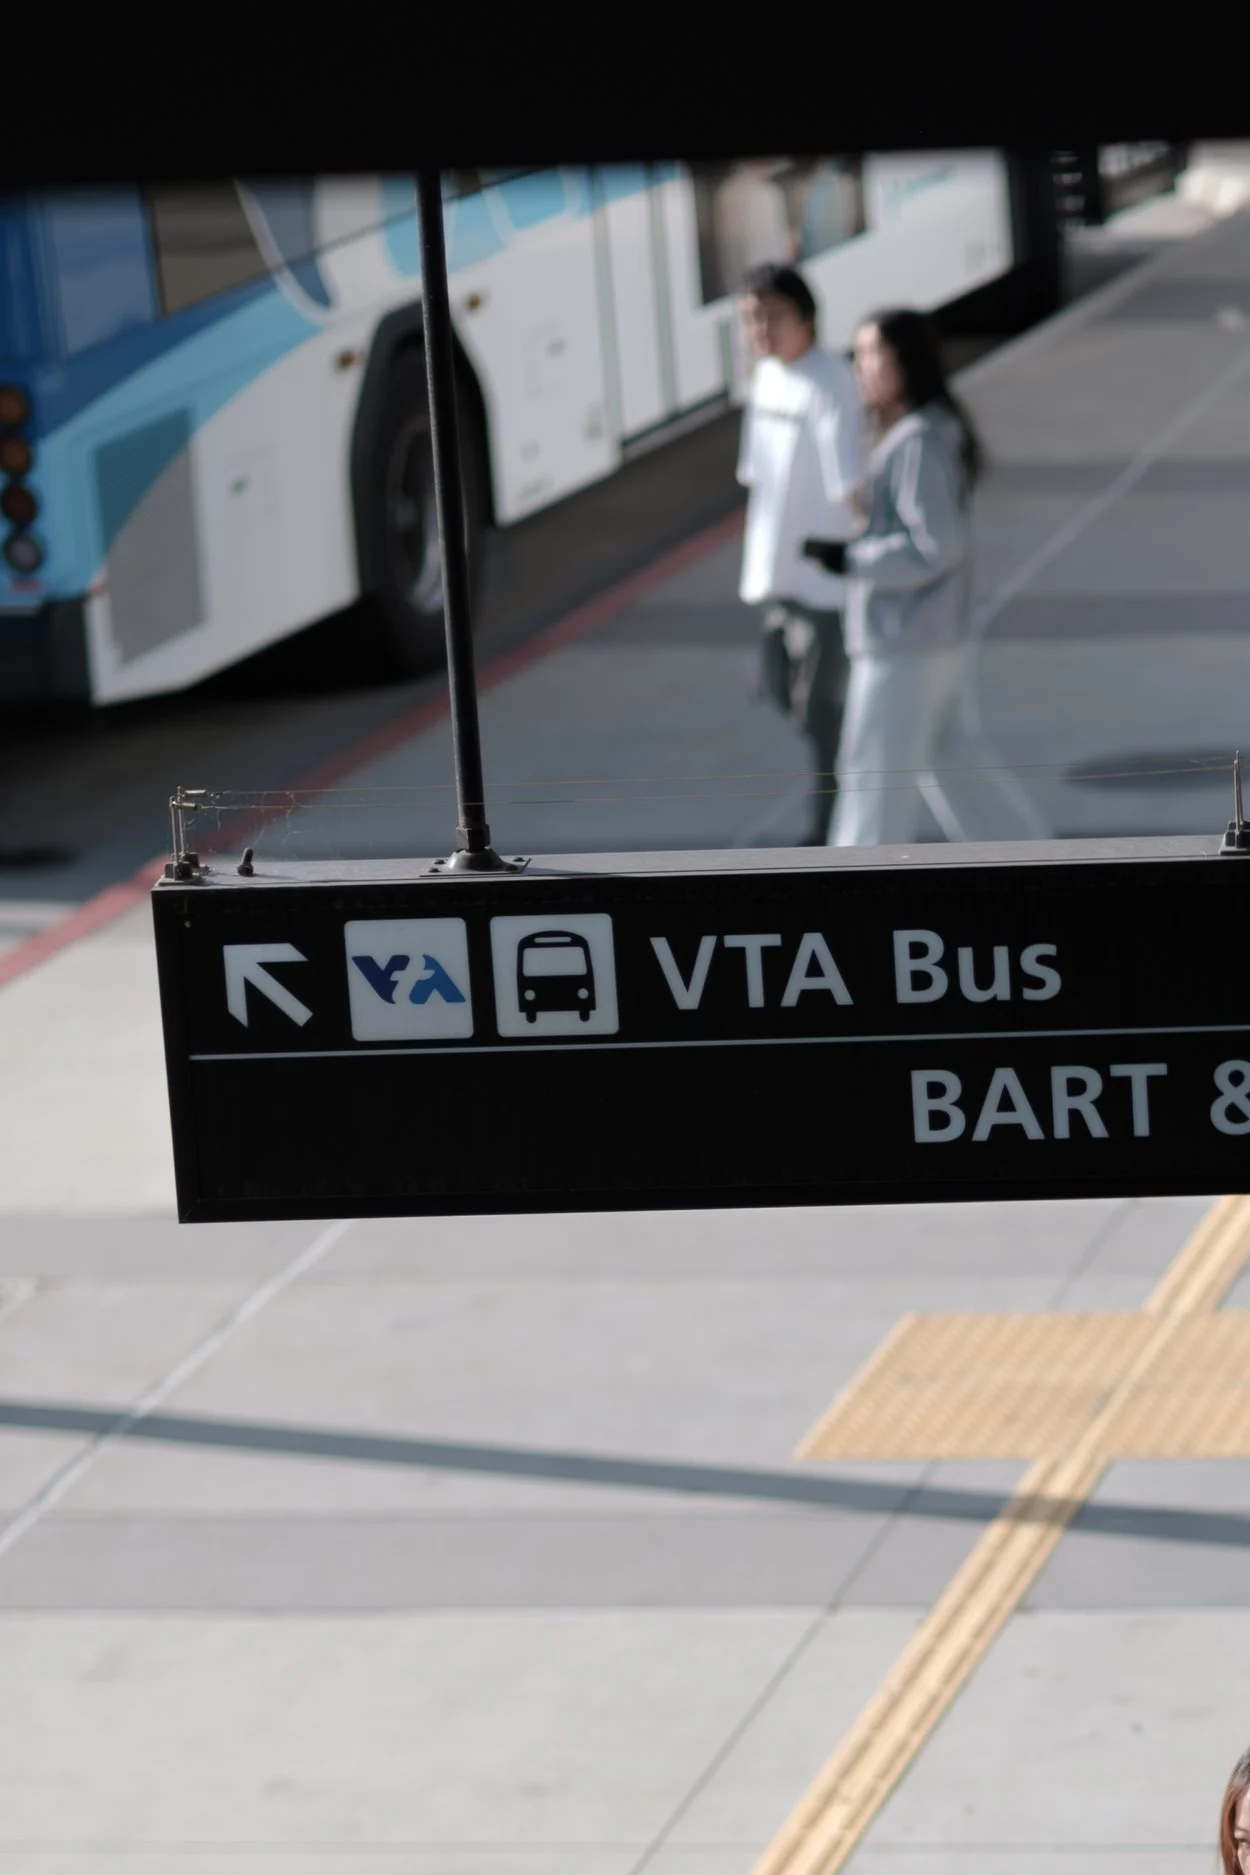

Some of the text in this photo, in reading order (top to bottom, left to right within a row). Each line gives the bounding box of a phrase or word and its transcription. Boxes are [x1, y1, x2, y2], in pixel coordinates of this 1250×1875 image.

[649, 929, 1062, 1010] VTA Bus
[911, 1063, 1168, 1143] BART
